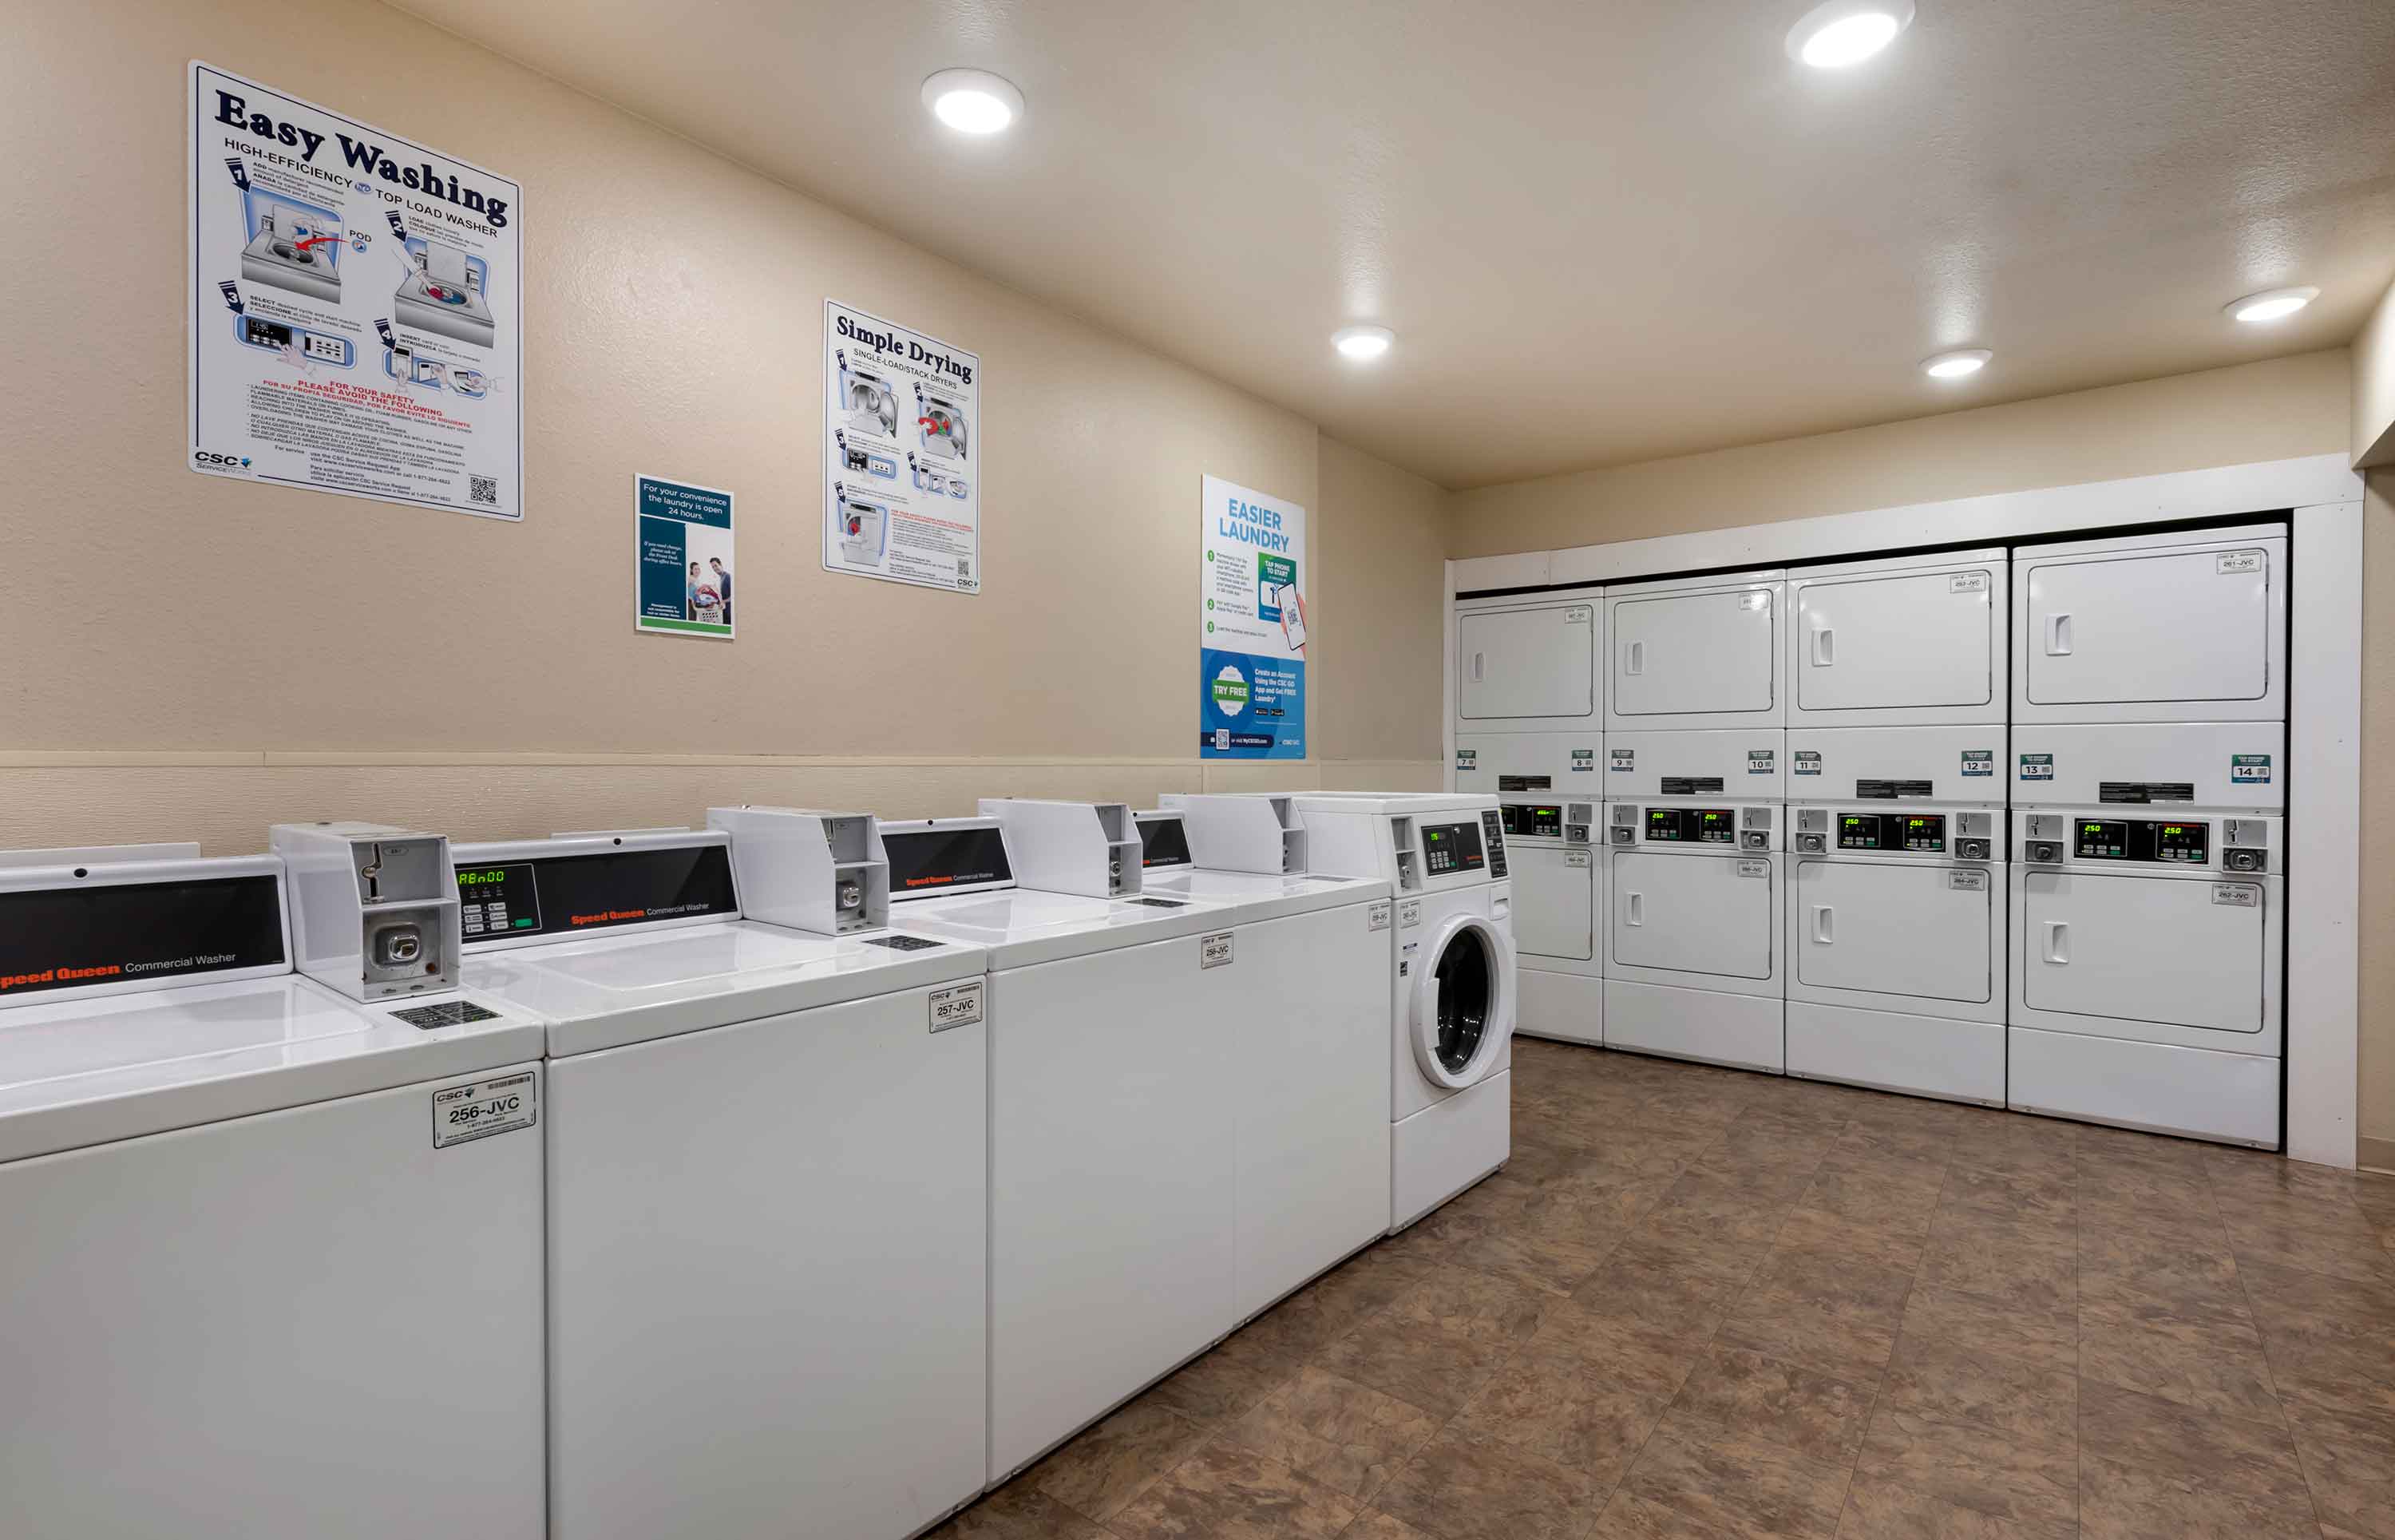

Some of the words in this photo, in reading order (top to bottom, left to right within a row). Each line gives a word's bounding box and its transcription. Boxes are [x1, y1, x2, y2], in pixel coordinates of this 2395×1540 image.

[215, 89, 325, 161] Easy
[335, 133, 508, 228] Washing
[234, 169, 242, 180] 1
[225, 137, 352, 188] HIGH-EFFICIENCY
[375, 188, 402, 204] TOP
[407, 200, 442, 219] LOAD
[446, 212, 497, 238] WASHER
[393, 221, 402, 230] 2
[350, 229, 372, 242] POD
[228, 291, 238, 303] 3
[249, 295, 275, 305] SELECT
[249, 300, 291, 315] SELECCIONE
[382, 330, 391, 339] 4
[837, 315, 904, 356] Simple
[909, 341, 972, 385] Drying
[853, 348, 929, 380] SINGLE-LOAD/STACK
[931, 374, 957, 390] DRYERS
[293, 386, 320, 396] PROPIA
[382, 405, 405, 414] FAVOR
[298, 380, 335, 394] PLEASE
[338, 389, 366, 400] AVOID
[370, 395, 388, 405] THE
[391, 400, 441, 416] FOLLOWING
[330, 381, 348, 390] FOR
[352, 386, 377, 396] YOUR
[380, 391, 414, 404] SAFETY
[195, 451, 238, 465] CSC
[643, 483, 658, 493] For
[660, 488, 678, 497] your
[679, 492, 727, 507] convenience
[648, 495, 662, 504] the
[663, 498, 693, 509] laundry
[703, 505, 722, 515] open
[680, 509, 704, 520] hours.
[1229, 497, 1281, 530] EASIER
[1220, 517, 1289, 552] LAUNDRY
[1274, 562, 1290, 572] PHONE
[1274, 569, 1288, 578] START
[1255, 677, 1268, 686] Using
[1213, 685, 1227, 695] TRY
[1229, 687, 1247, 697] FREE
[572, 912, 608, 925] Speed
[609, 909, 645, 920] Queen
[647, 905, 685, 916] Commercial
[686, 902, 710, 911] Washer
[1206, 945, 1229, 956] 258-JVC
[0, 969, 53, 989] peed
[57, 965, 120, 980] Queen
[125, 957, 192, 973] Commercial
[195, 952, 236, 964] Washer
[937, 1000, 974, 1016] 257-JVC
[437, 1091, 463, 1103] CSC
[449, 1096, 520, 1123] 256-JVC
